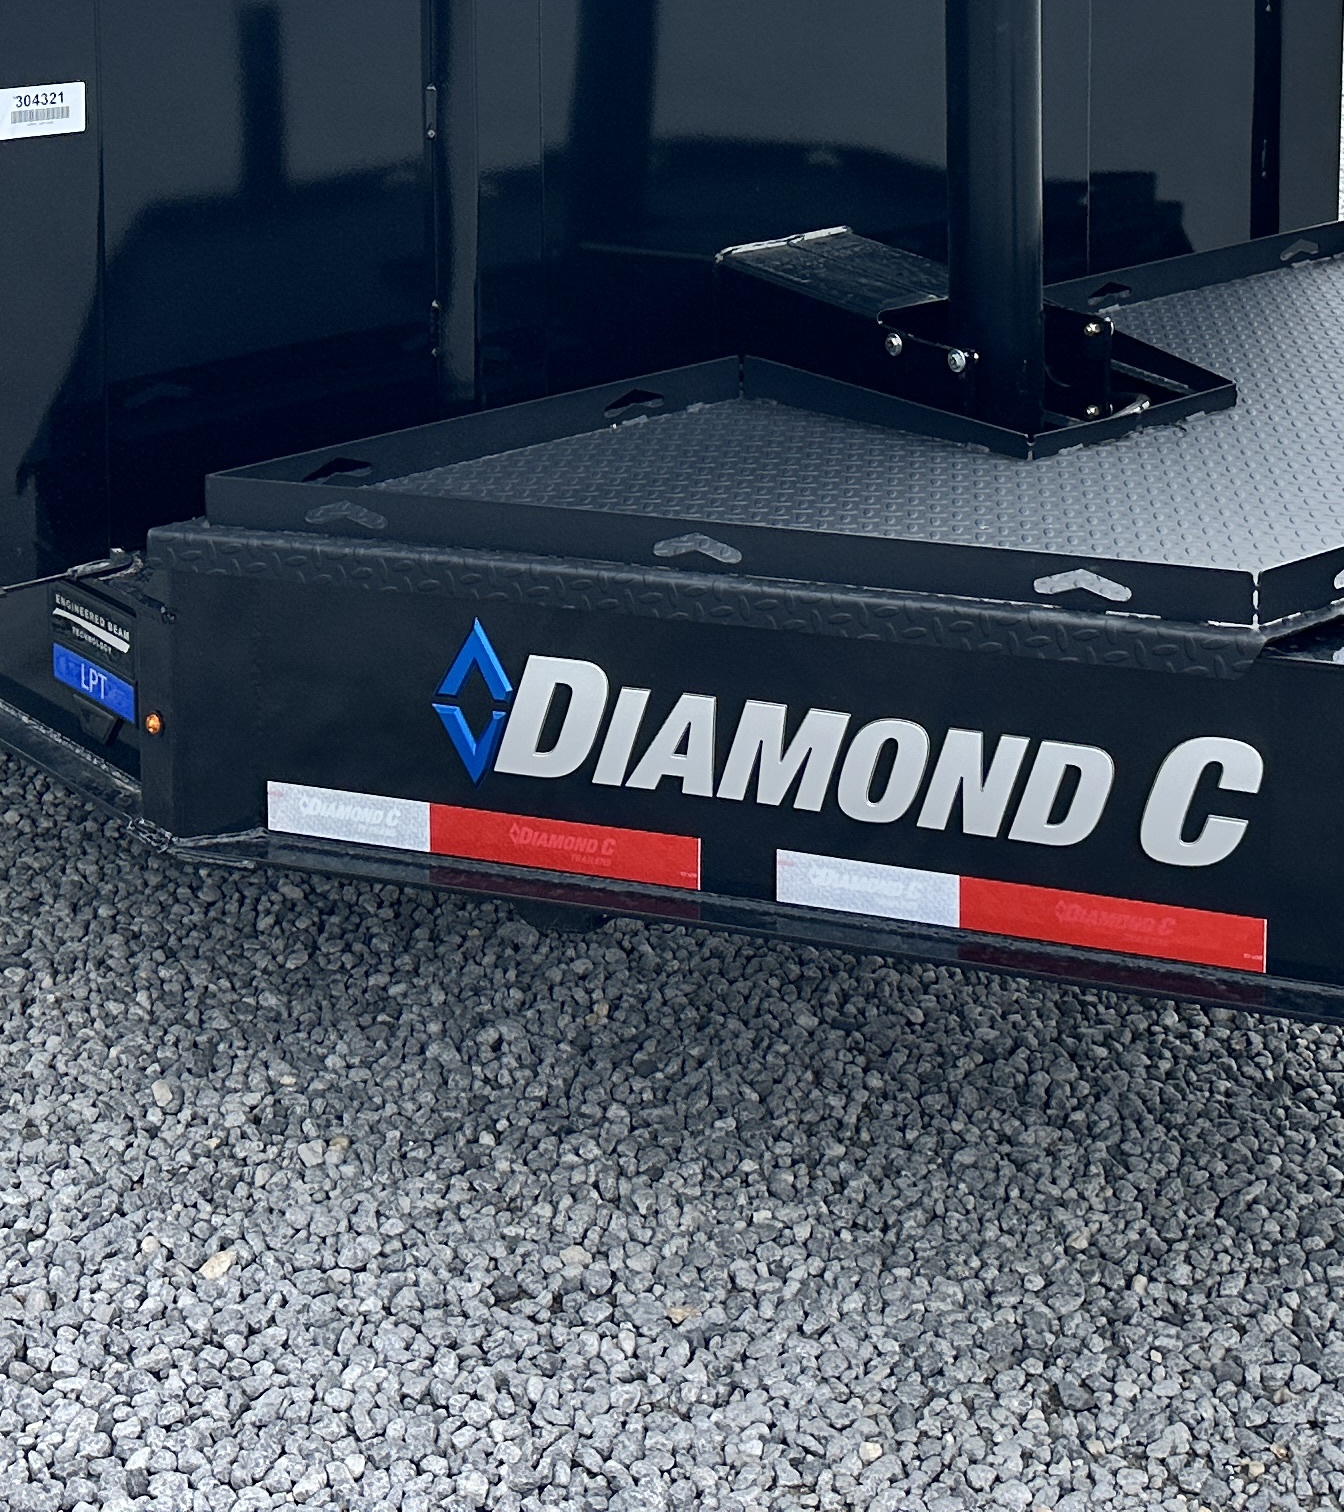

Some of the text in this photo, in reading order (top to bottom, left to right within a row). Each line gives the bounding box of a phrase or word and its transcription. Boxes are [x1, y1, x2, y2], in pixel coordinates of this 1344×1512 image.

[15, 90, 64, 108] 304321
[55, 593, 130, 642] ENGINEERED BEAM
[71, 626, 112, 654] TECHNOLOGY
[81, 663, 108, 700] LPT
[493, 653, 1264, 868] DIAMOND C
[307, 797, 401, 826] DIAMOND C
[520, 826, 617, 856] DIAMOND C
